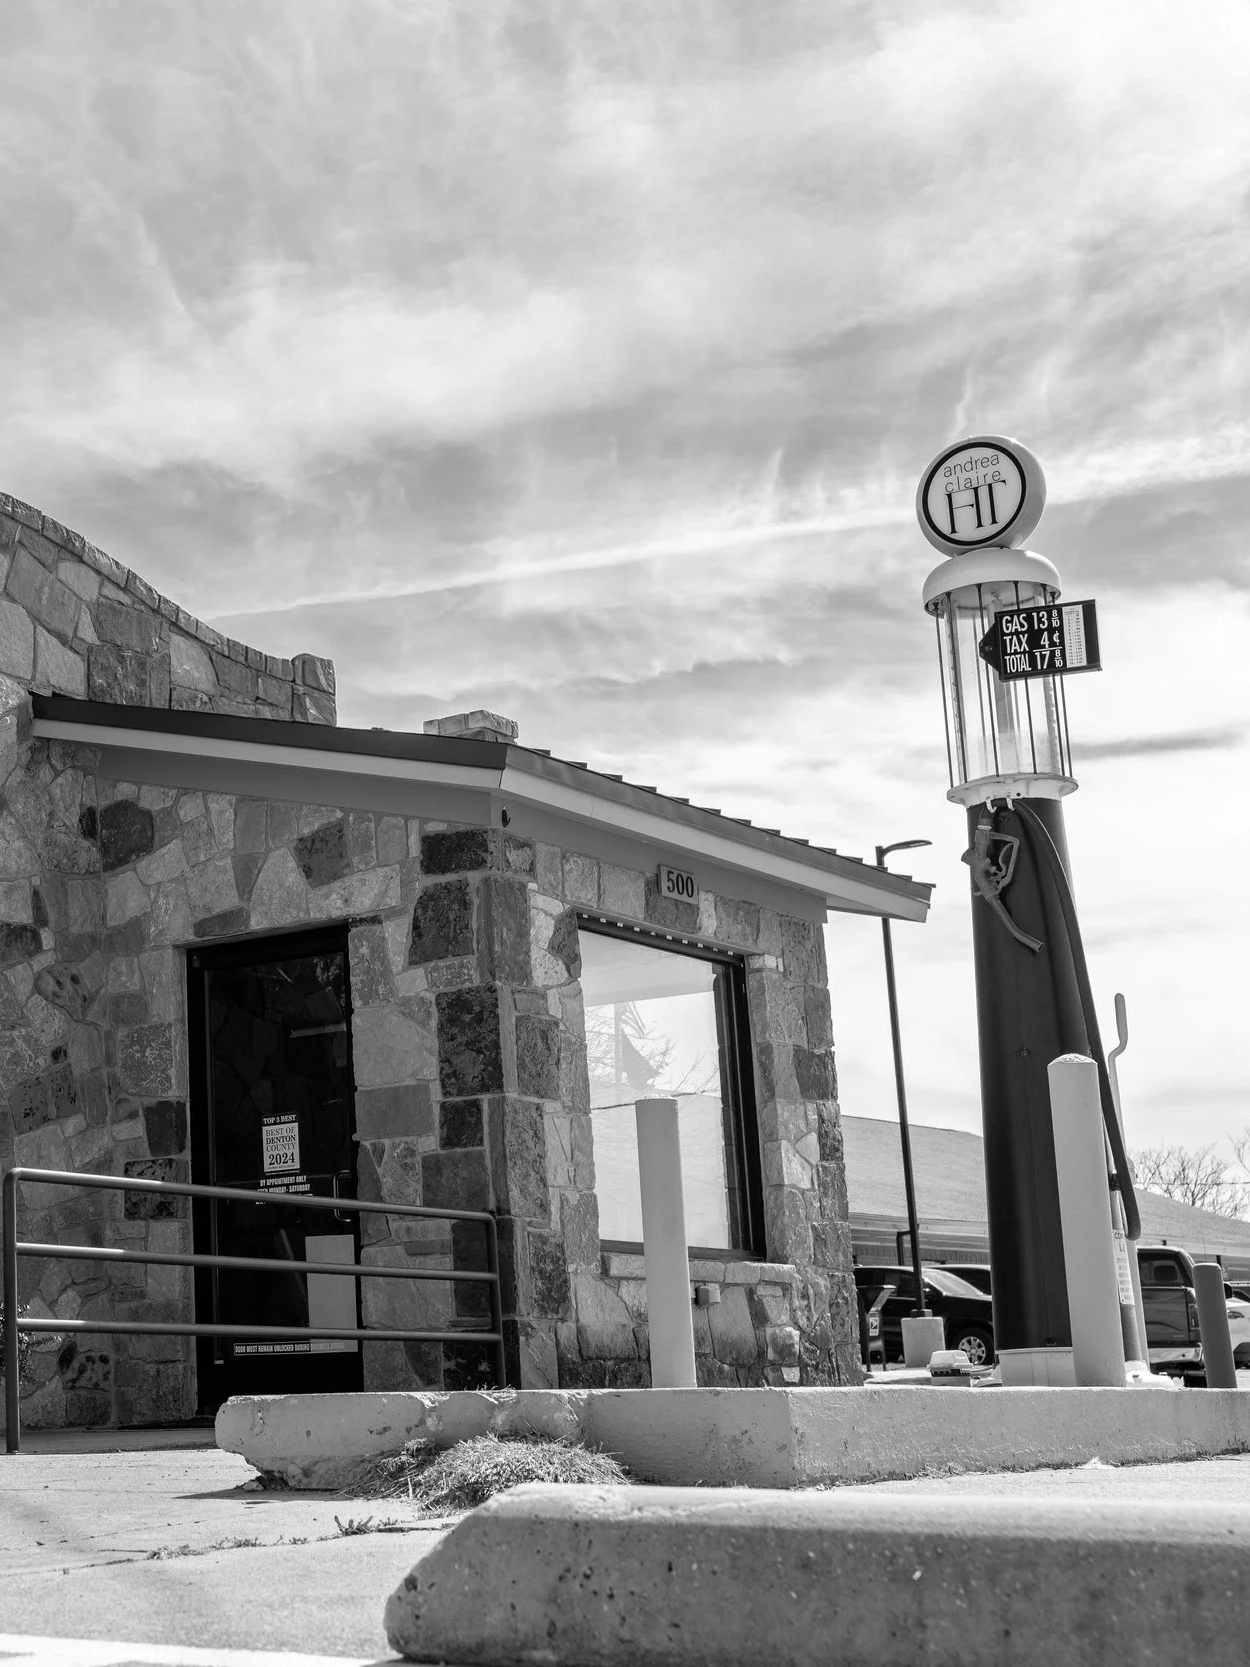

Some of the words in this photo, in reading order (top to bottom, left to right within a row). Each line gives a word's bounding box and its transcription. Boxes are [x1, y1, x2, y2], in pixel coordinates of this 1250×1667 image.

[943, 454, 1000, 478] andrea
[945, 470, 1001, 493] claire
[1002, 613, 1028, 634] GAS
[1031, 611, 1049, 630] 13
[1003, 633, 1029, 654] TAX
[1040, 631, 1050, 649] 4
[1004, 653, 1032, 673] TOTAL
[1034, 650, 1051, 670] 17
[666, 869, 695, 898] 500
[265, 1128, 285, 1136] BEST
[285, 1126, 296, 1134] OF
[266, 1134, 296, 1145] DENTON
[266, 1142, 296, 1152] COUNTY
[268, 1151, 296, 1166] 2024
[260, 1179, 266, 1187] BY
[266, 1176, 295, 1186] APPOINTMENT
[296, 1175, 307, 1183] ONLY
[289, 1184, 311, 1192] SATURDAY
[235, 1345, 246, 1353] DOOR
[246, 1345, 258, 1353] MUST
[258, 1344, 274, 1352] REMAIN
[273, 1343, 294, 1352] UNLOCKED
[294, 1343, 310, 1352] DURING
